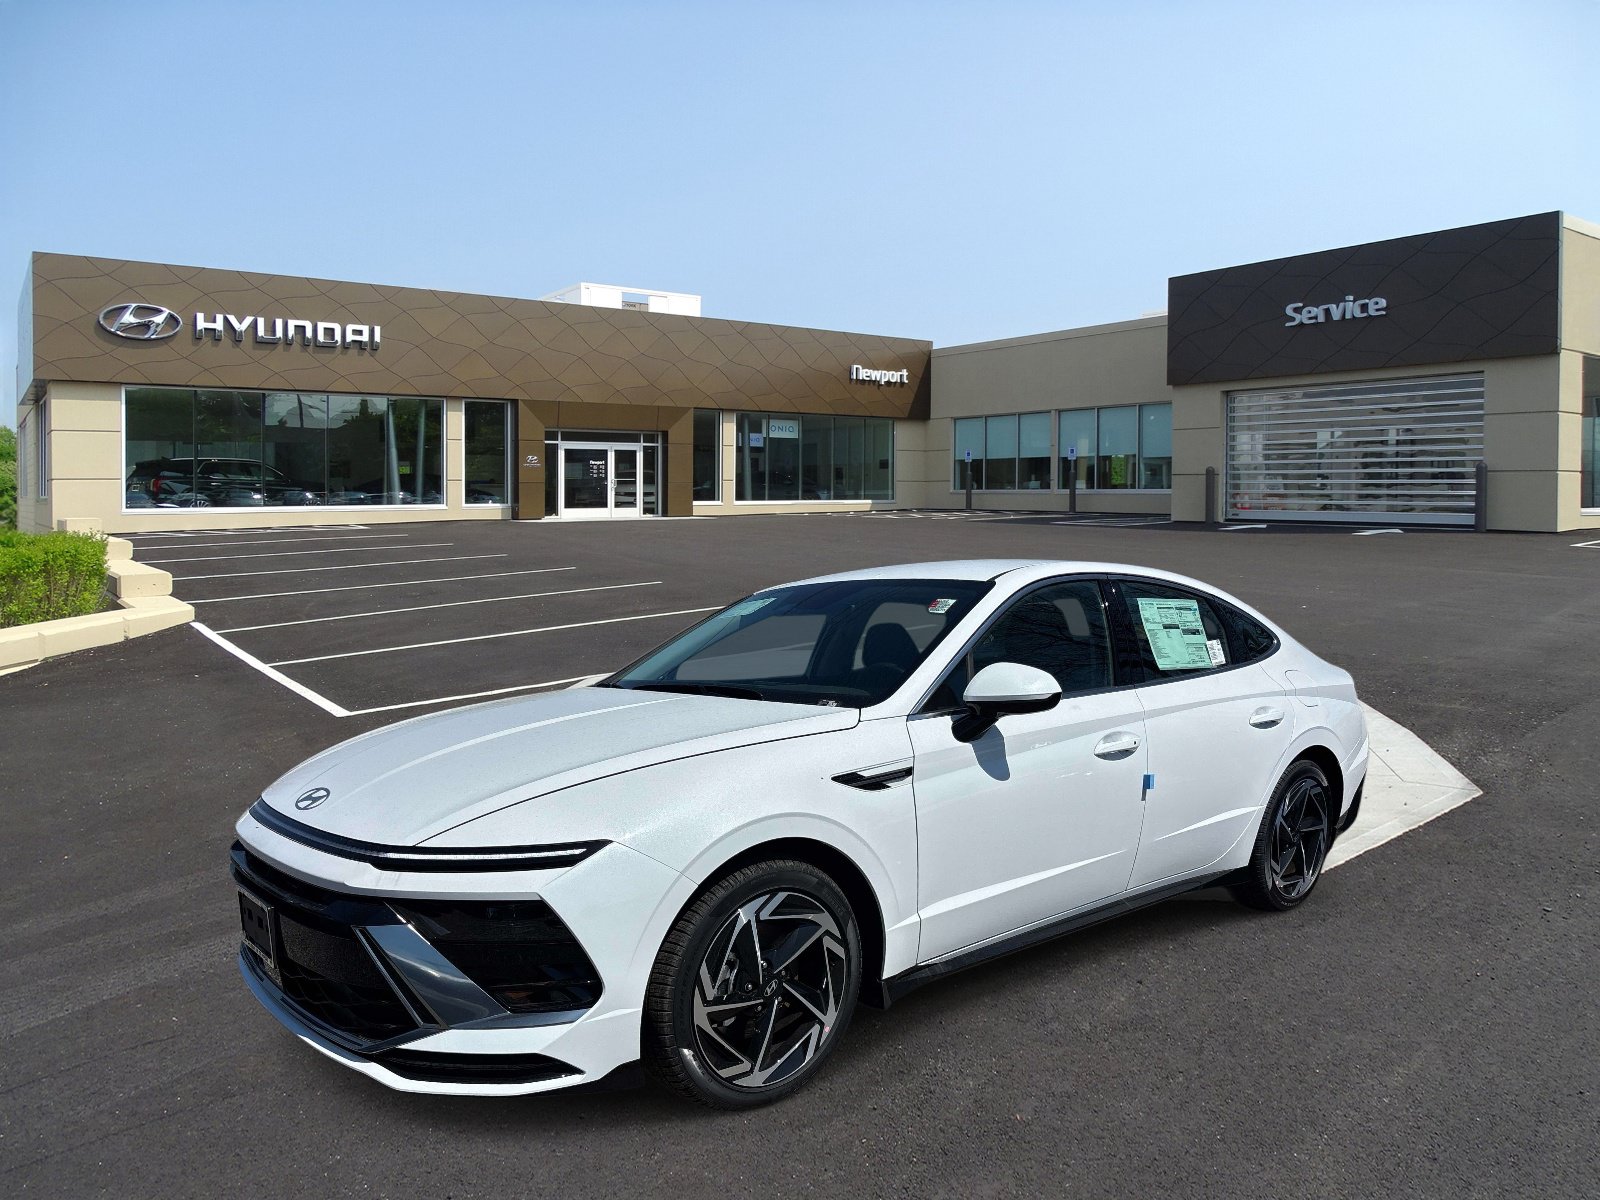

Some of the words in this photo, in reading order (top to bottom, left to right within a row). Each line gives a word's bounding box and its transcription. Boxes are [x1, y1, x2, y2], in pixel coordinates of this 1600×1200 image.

[1285, 295, 1387, 326] Service
[195, 312, 381, 350] HYUNDAI
[850, 364, 909, 385] Newport
